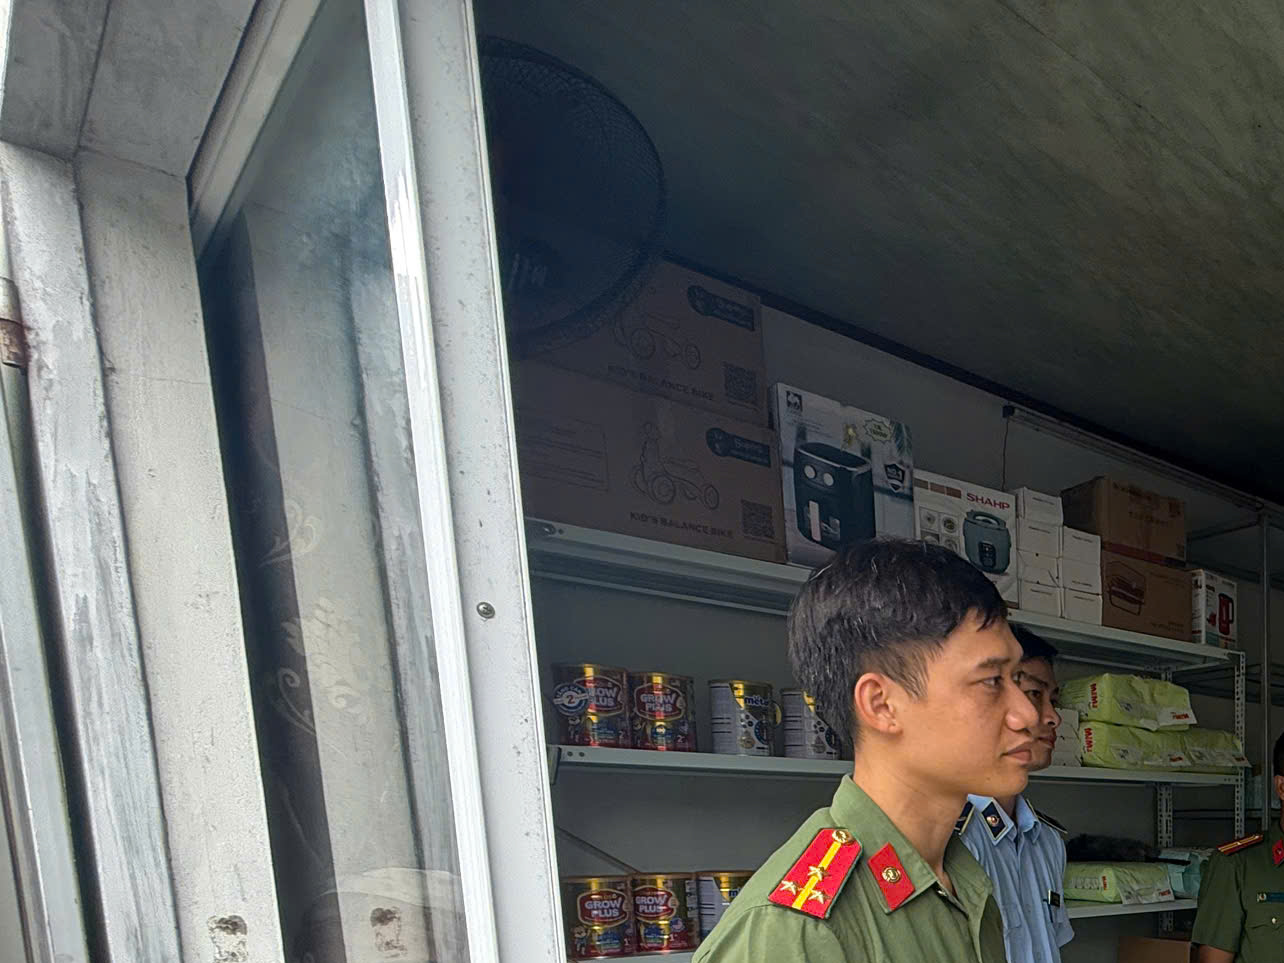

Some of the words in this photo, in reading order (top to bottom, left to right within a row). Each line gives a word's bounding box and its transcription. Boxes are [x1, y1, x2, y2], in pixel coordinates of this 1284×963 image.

[966, 492, 1010, 510] SHARP
[586, 686, 617, 698] ROW
[640, 692, 675, 703] GROW
[644, 701, 673, 712] PLUS
[584, 900, 622, 911] GROW
[635, 896, 669, 906] GROW
[590, 908, 619, 918] PLUS
[635, 904, 665, 914] PLUS
